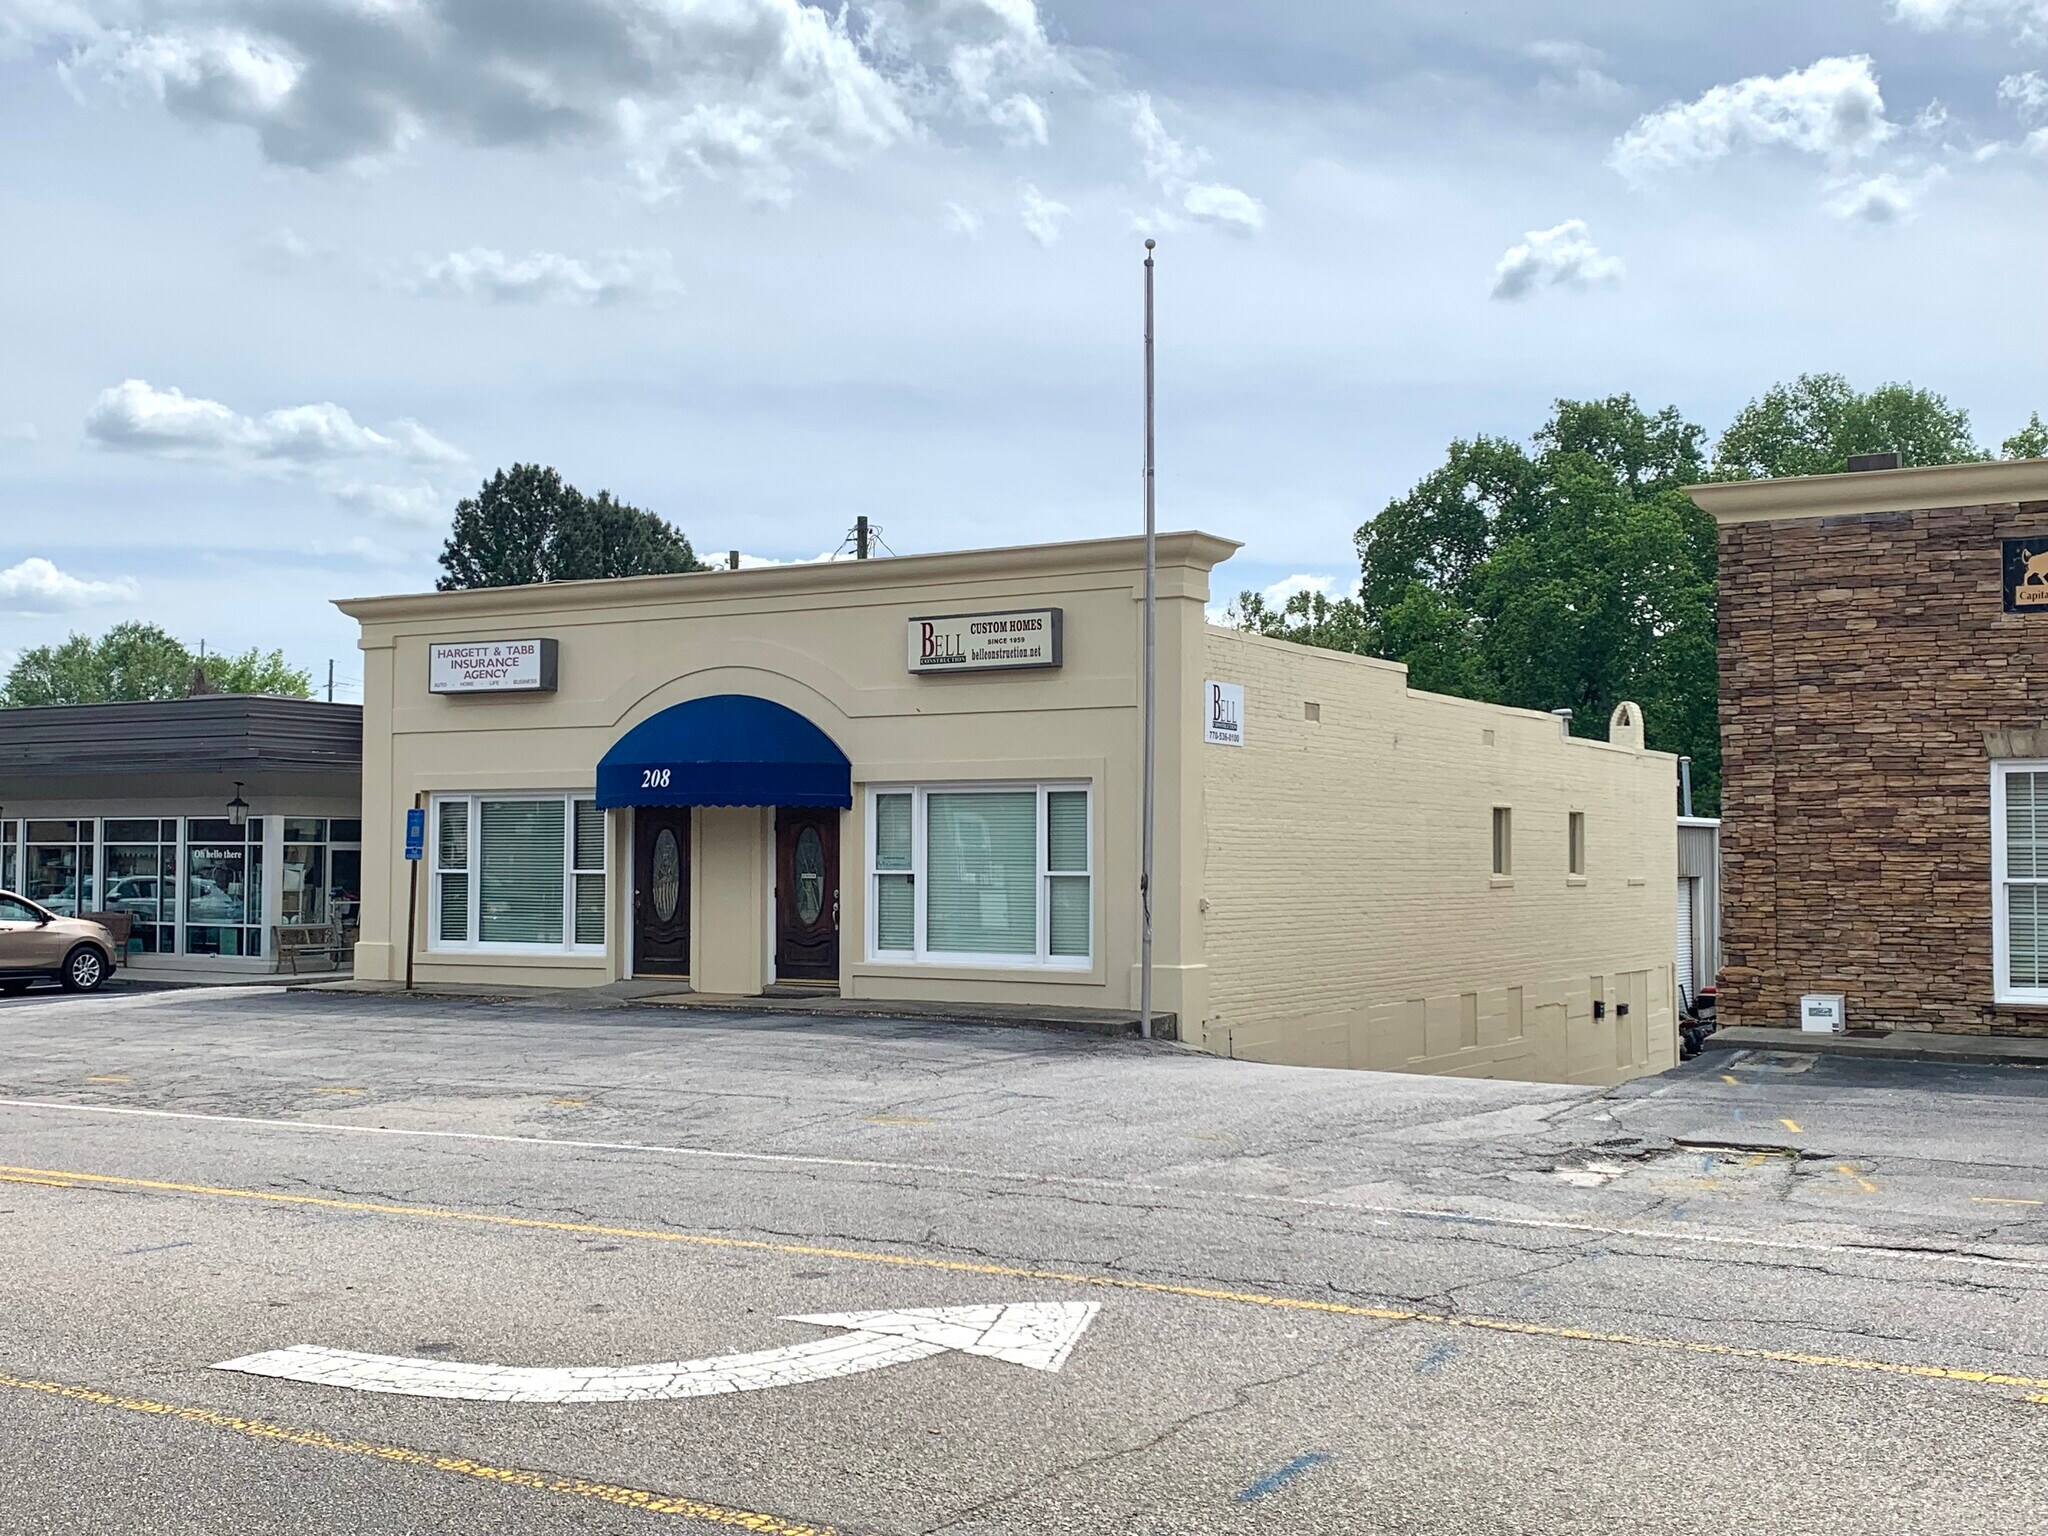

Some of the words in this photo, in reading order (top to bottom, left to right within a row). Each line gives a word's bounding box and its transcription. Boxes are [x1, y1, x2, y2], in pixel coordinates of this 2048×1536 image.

[971, 622, 1007, 634] CUSTOM
[1010, 619, 1042, 631] HOMES
[438, 647, 489, 658] HARGETT
[493, 647, 502, 656] &
[506, 645, 535, 656] TABB
[972, 645, 1041, 660] bellconstruction.net
[451, 657, 519, 669] INSURANCE
[920, 656, 966, 665] CONSTRUCTION
[464, 669, 508, 679] AGENCY
[641, 768, 671, 788] 208
[194, 849, 205, 859] Oh
[206, 849, 223, 858] hello
[224, 849, 242, 858] there
